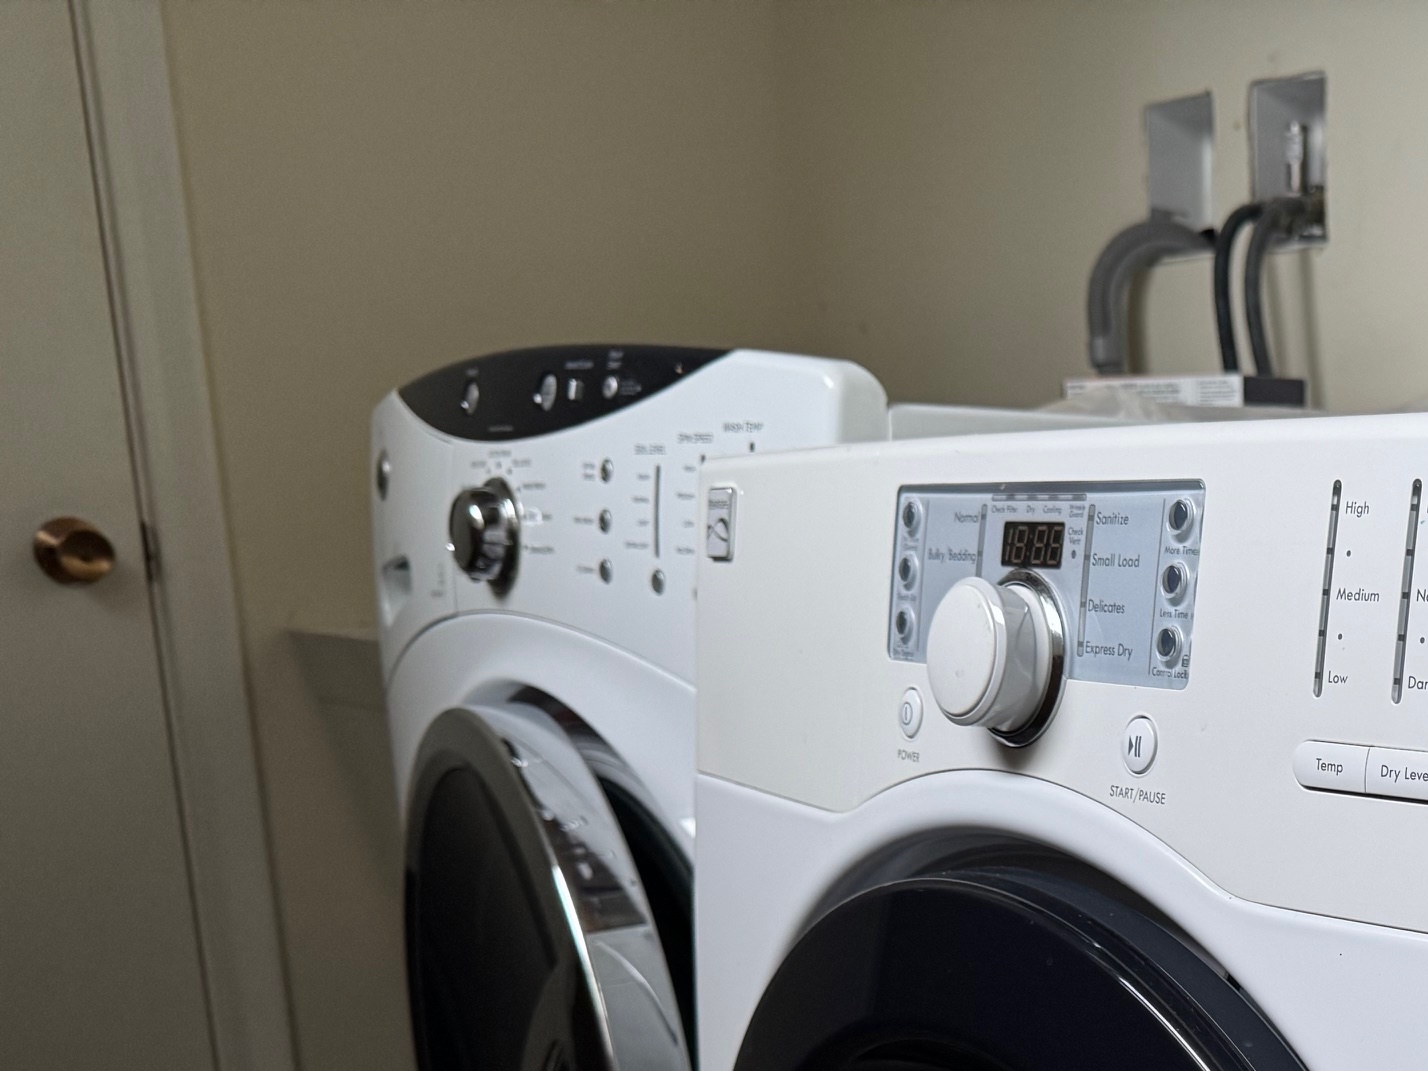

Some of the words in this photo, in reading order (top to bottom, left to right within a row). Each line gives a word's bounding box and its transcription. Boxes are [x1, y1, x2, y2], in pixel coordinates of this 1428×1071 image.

[1345, 501, 1370, 517] High
[954, 511, 981, 524] Normal
[1096, 511, 1130, 525] Sanitize
[1165, 546, 1180, 555] More
[1092, 553, 1115, 567] Small
[1118, 554, 1140, 568] Load
[1336, 588, 1380, 603] Medium
[1088, 599, 1125, 614] Delicates
[1160, 609, 1172, 618] Less
[1174, 609, 1189, 619] Time
[1085, 641, 1115, 658] Express
[1118, 643, 1133, 661] Dry
[1327, 671, 1348, 684] Low
[897, 749, 920, 763] POWER
[1316, 758, 1344, 775] Temp
[1380, 764, 1401, 783] Dry
[1109, 785, 1166, 805] START/PAUSE
